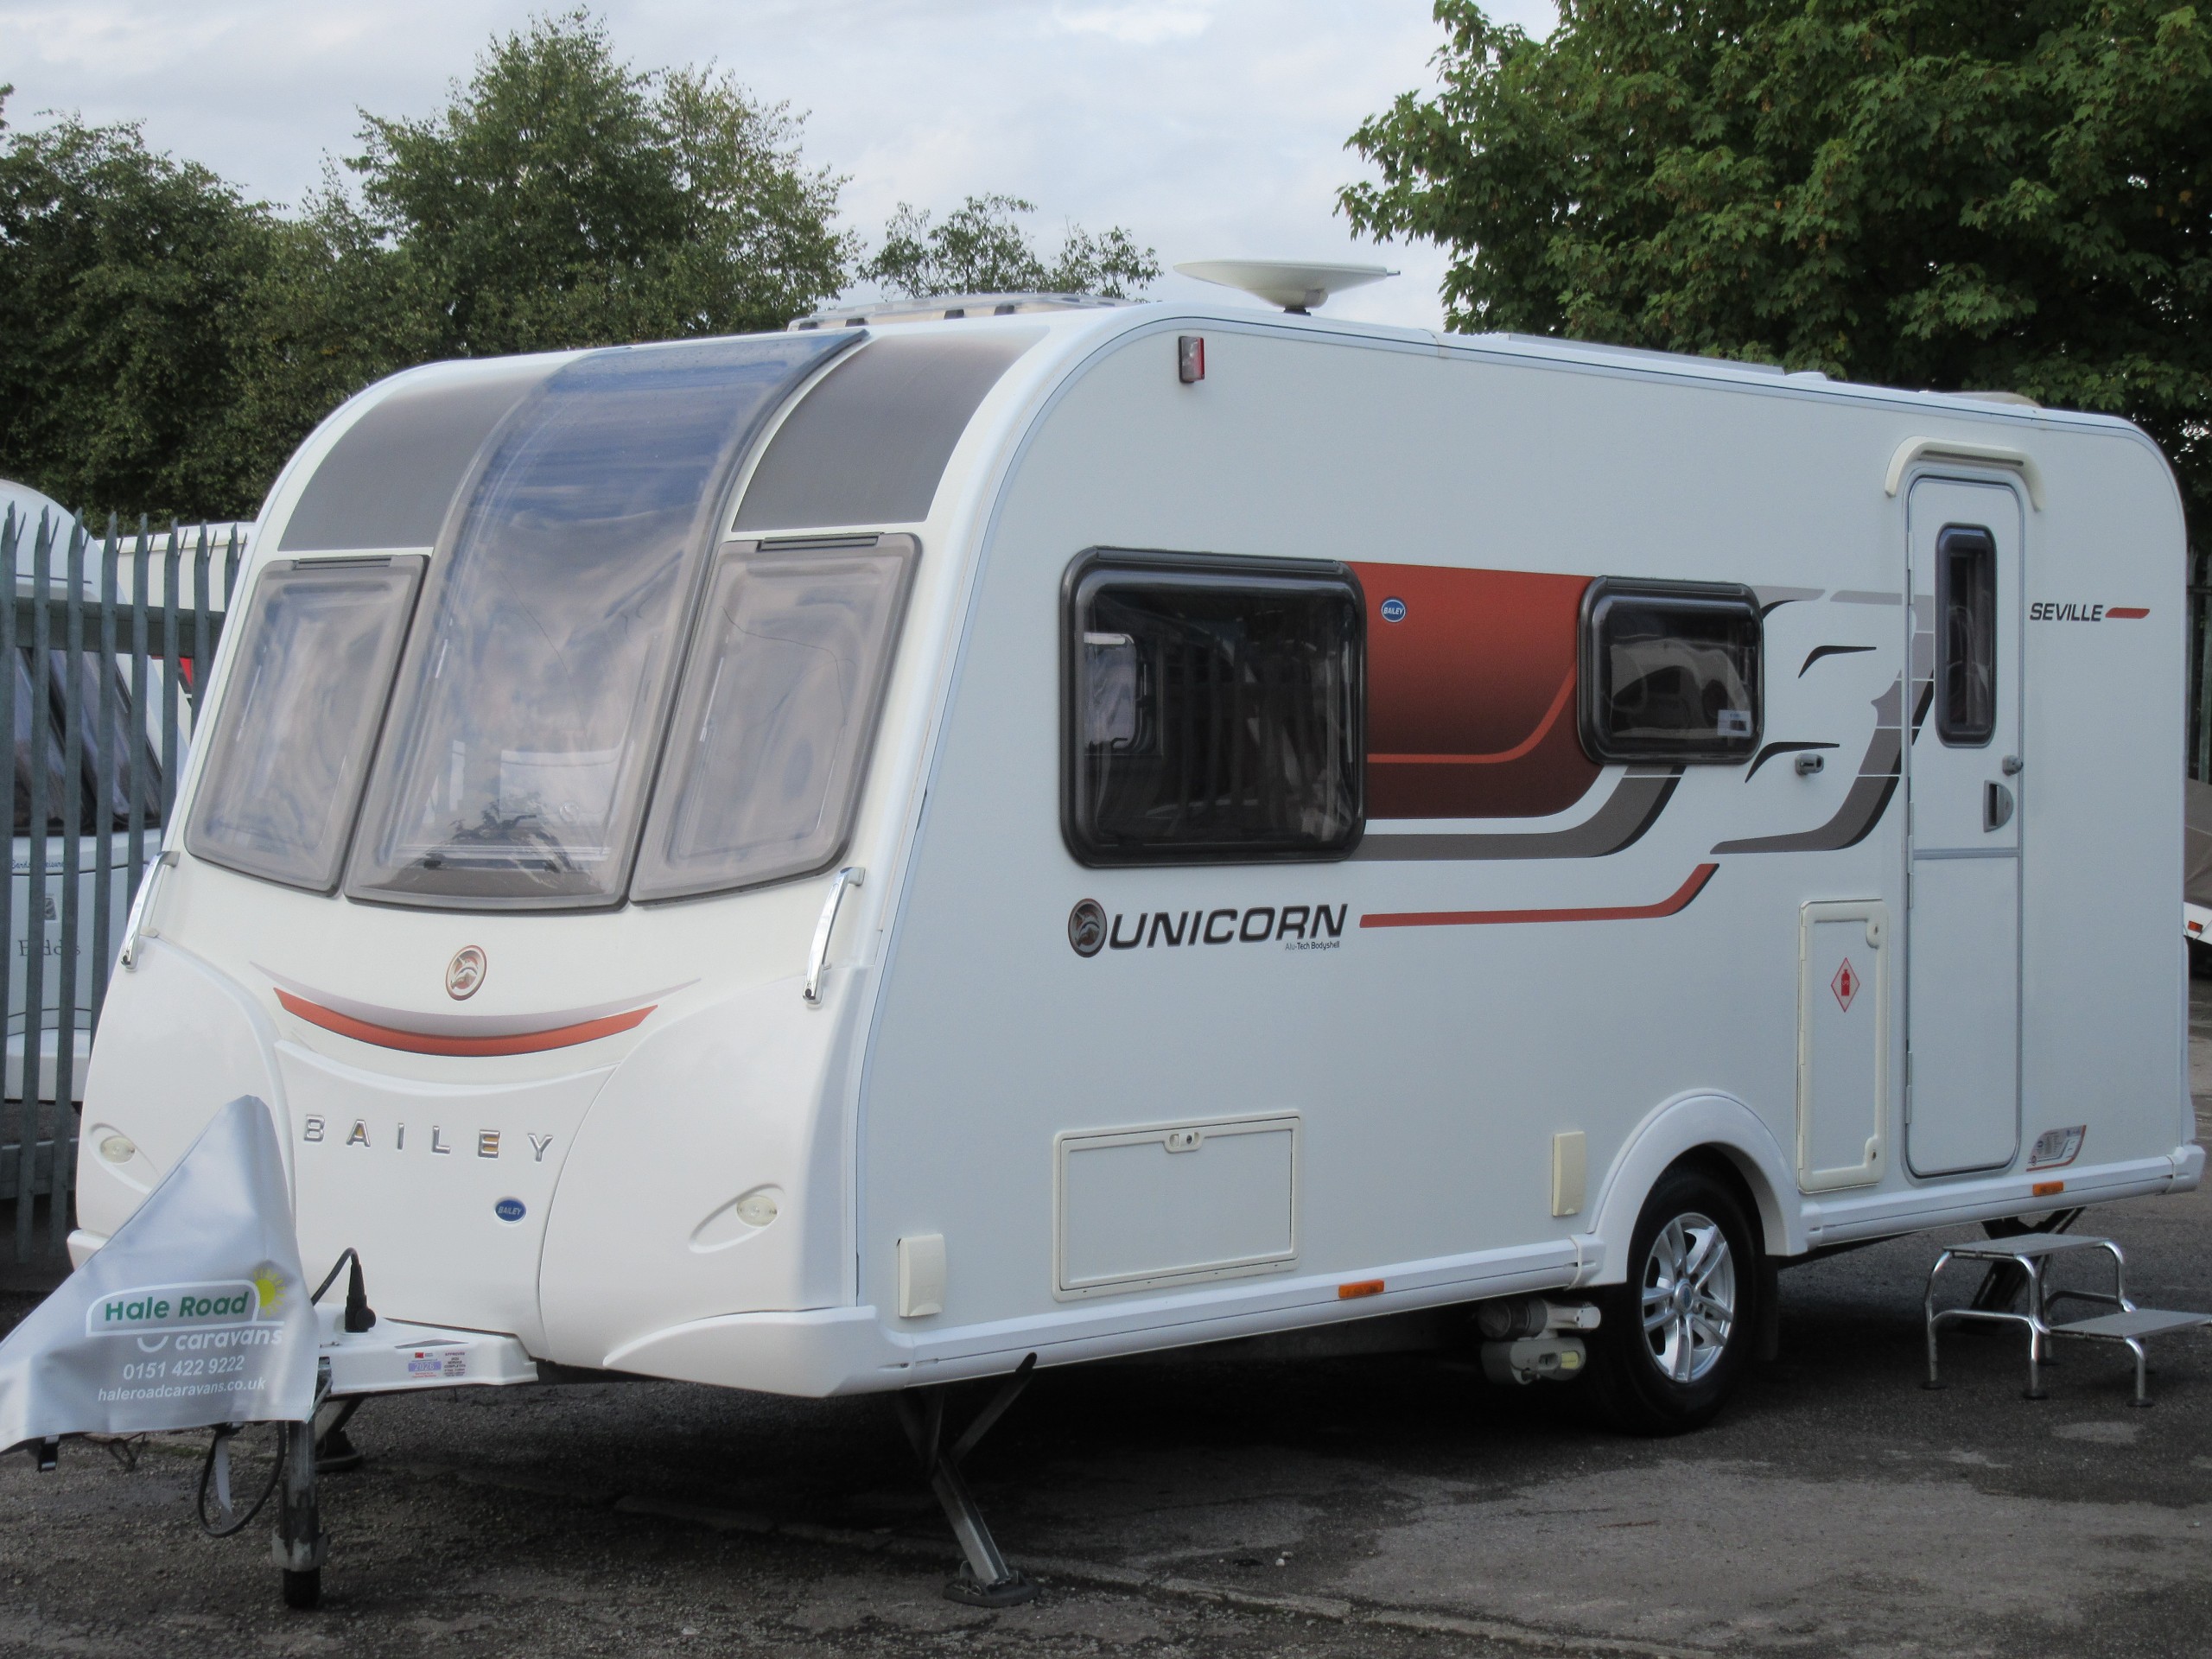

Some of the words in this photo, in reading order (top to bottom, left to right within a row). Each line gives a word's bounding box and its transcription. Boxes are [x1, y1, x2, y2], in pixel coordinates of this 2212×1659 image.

[1382, 607, 1404, 615] BAILEY
[2030, 602, 2103, 621] SEVILLE
[1109, 903, 1348, 950] UNICORN
[1285, 942, 1310, 950] Alu-Tech
[1311, 941, 1340, 950] Bodyshell
[303, 1114, 553, 1162] BAILEY
[498, 1206, 522, 1216] BAILEY
[105, 1296, 170, 1321] Hale
[179, 1291, 249, 1318] Road
[175, 1327, 284, 1351] caravans
[123, 1361, 166, 1380] 0151
[171, 1358, 204, 1376] 422
[208, 1355, 245, 1374] 9222
[98, 1377, 266, 1402] haleroadcaravans.co.uk
